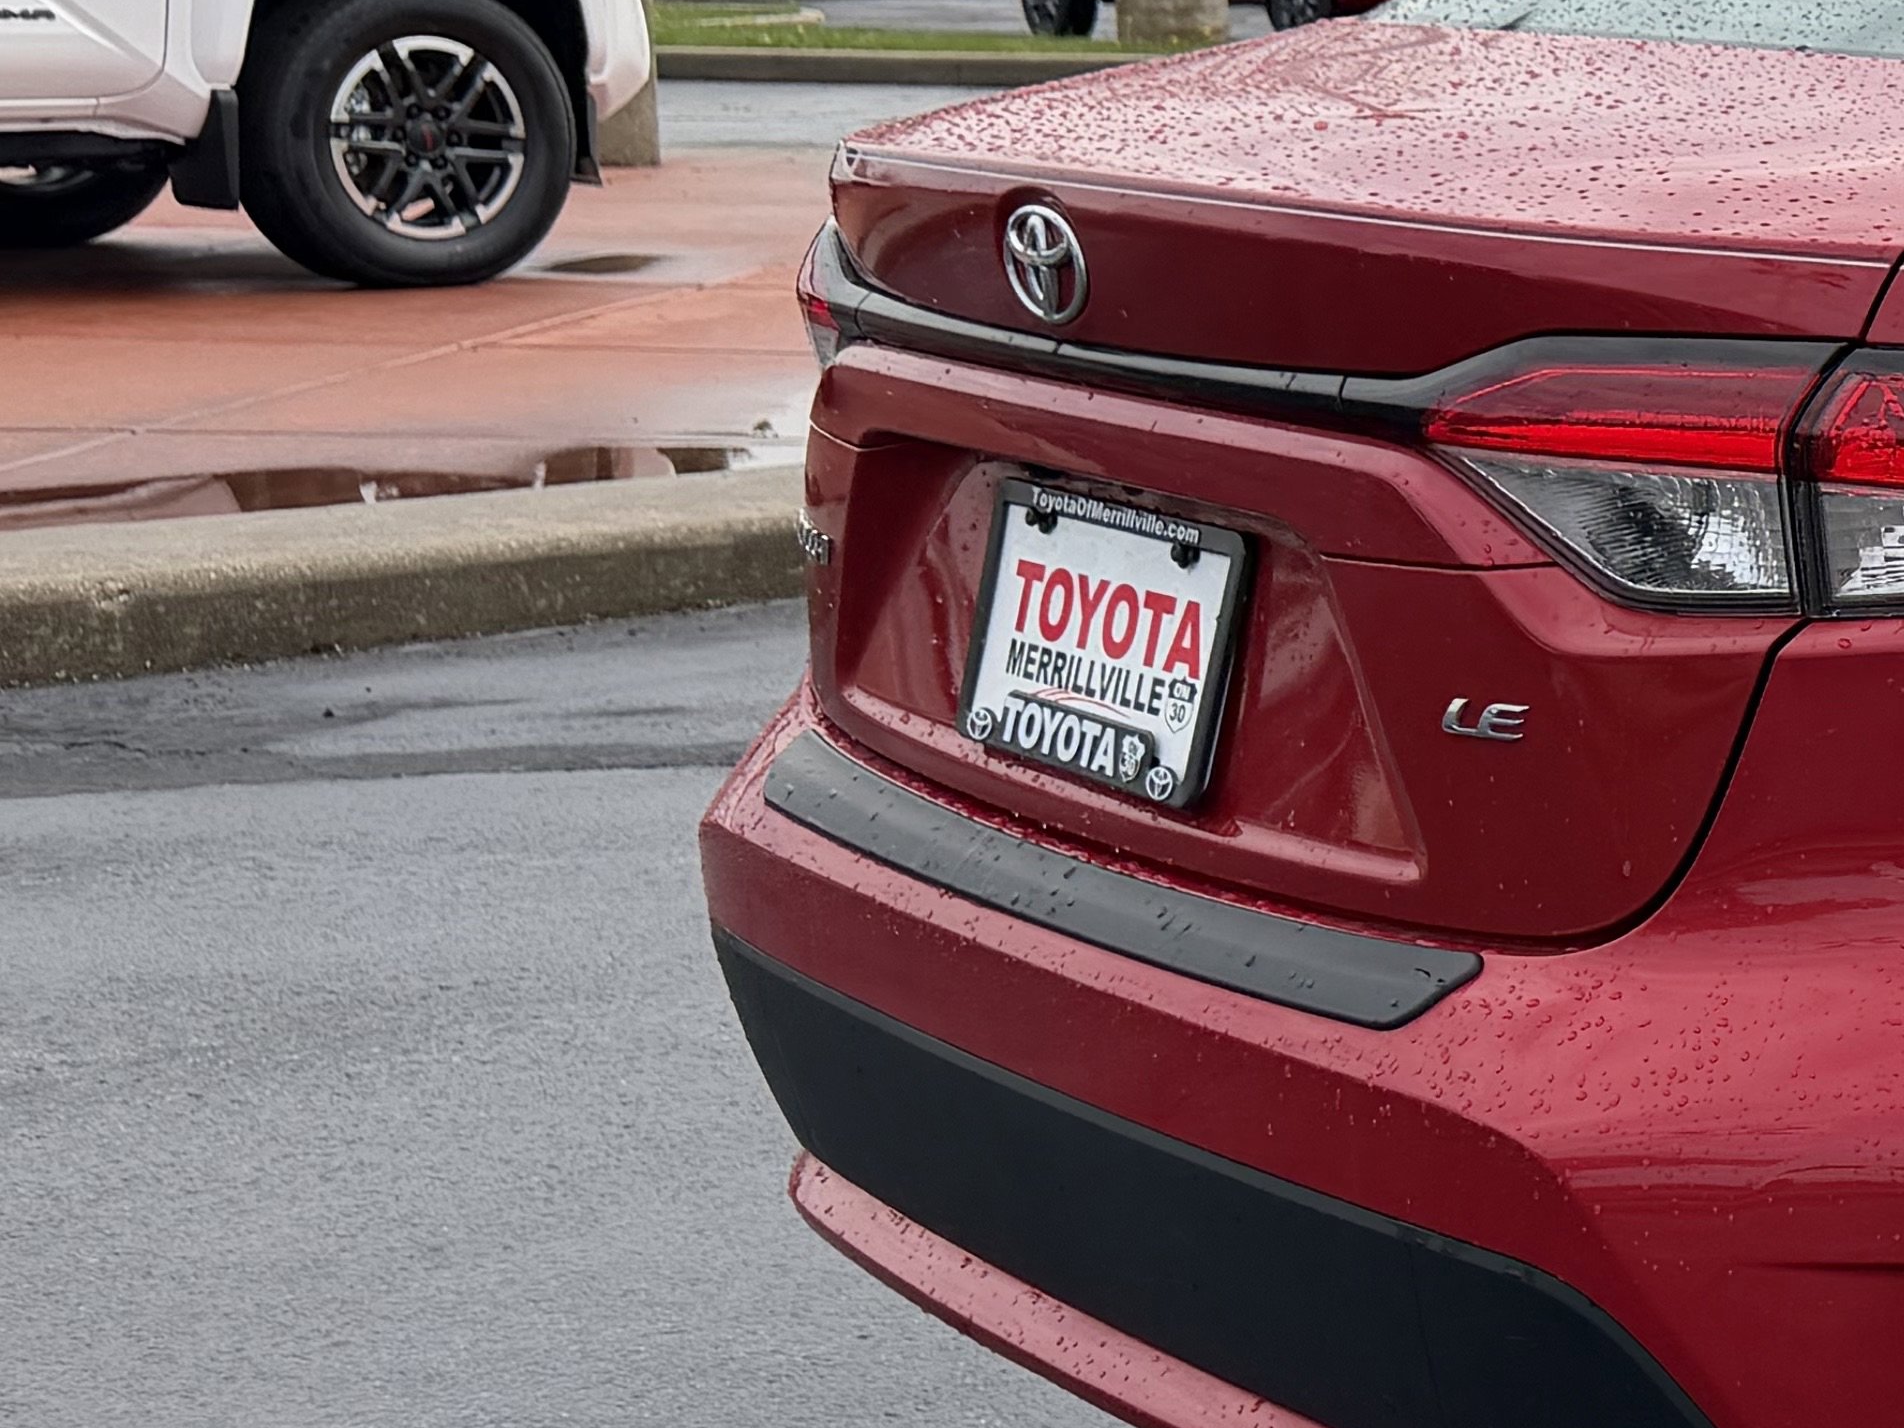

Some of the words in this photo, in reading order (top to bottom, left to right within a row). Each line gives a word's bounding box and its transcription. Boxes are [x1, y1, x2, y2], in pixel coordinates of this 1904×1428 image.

[1032, 485, 1200, 544] ToyotaOfMerrillville.com
[1014, 558, 1201, 680] TOYOTA
[1006, 638, 1166, 717] MERRILLVILLE
[1003, 696, 1116, 778] TOYOTA
[1169, 703, 1187, 723] 30
[1442, 698, 1530, 741] LE
